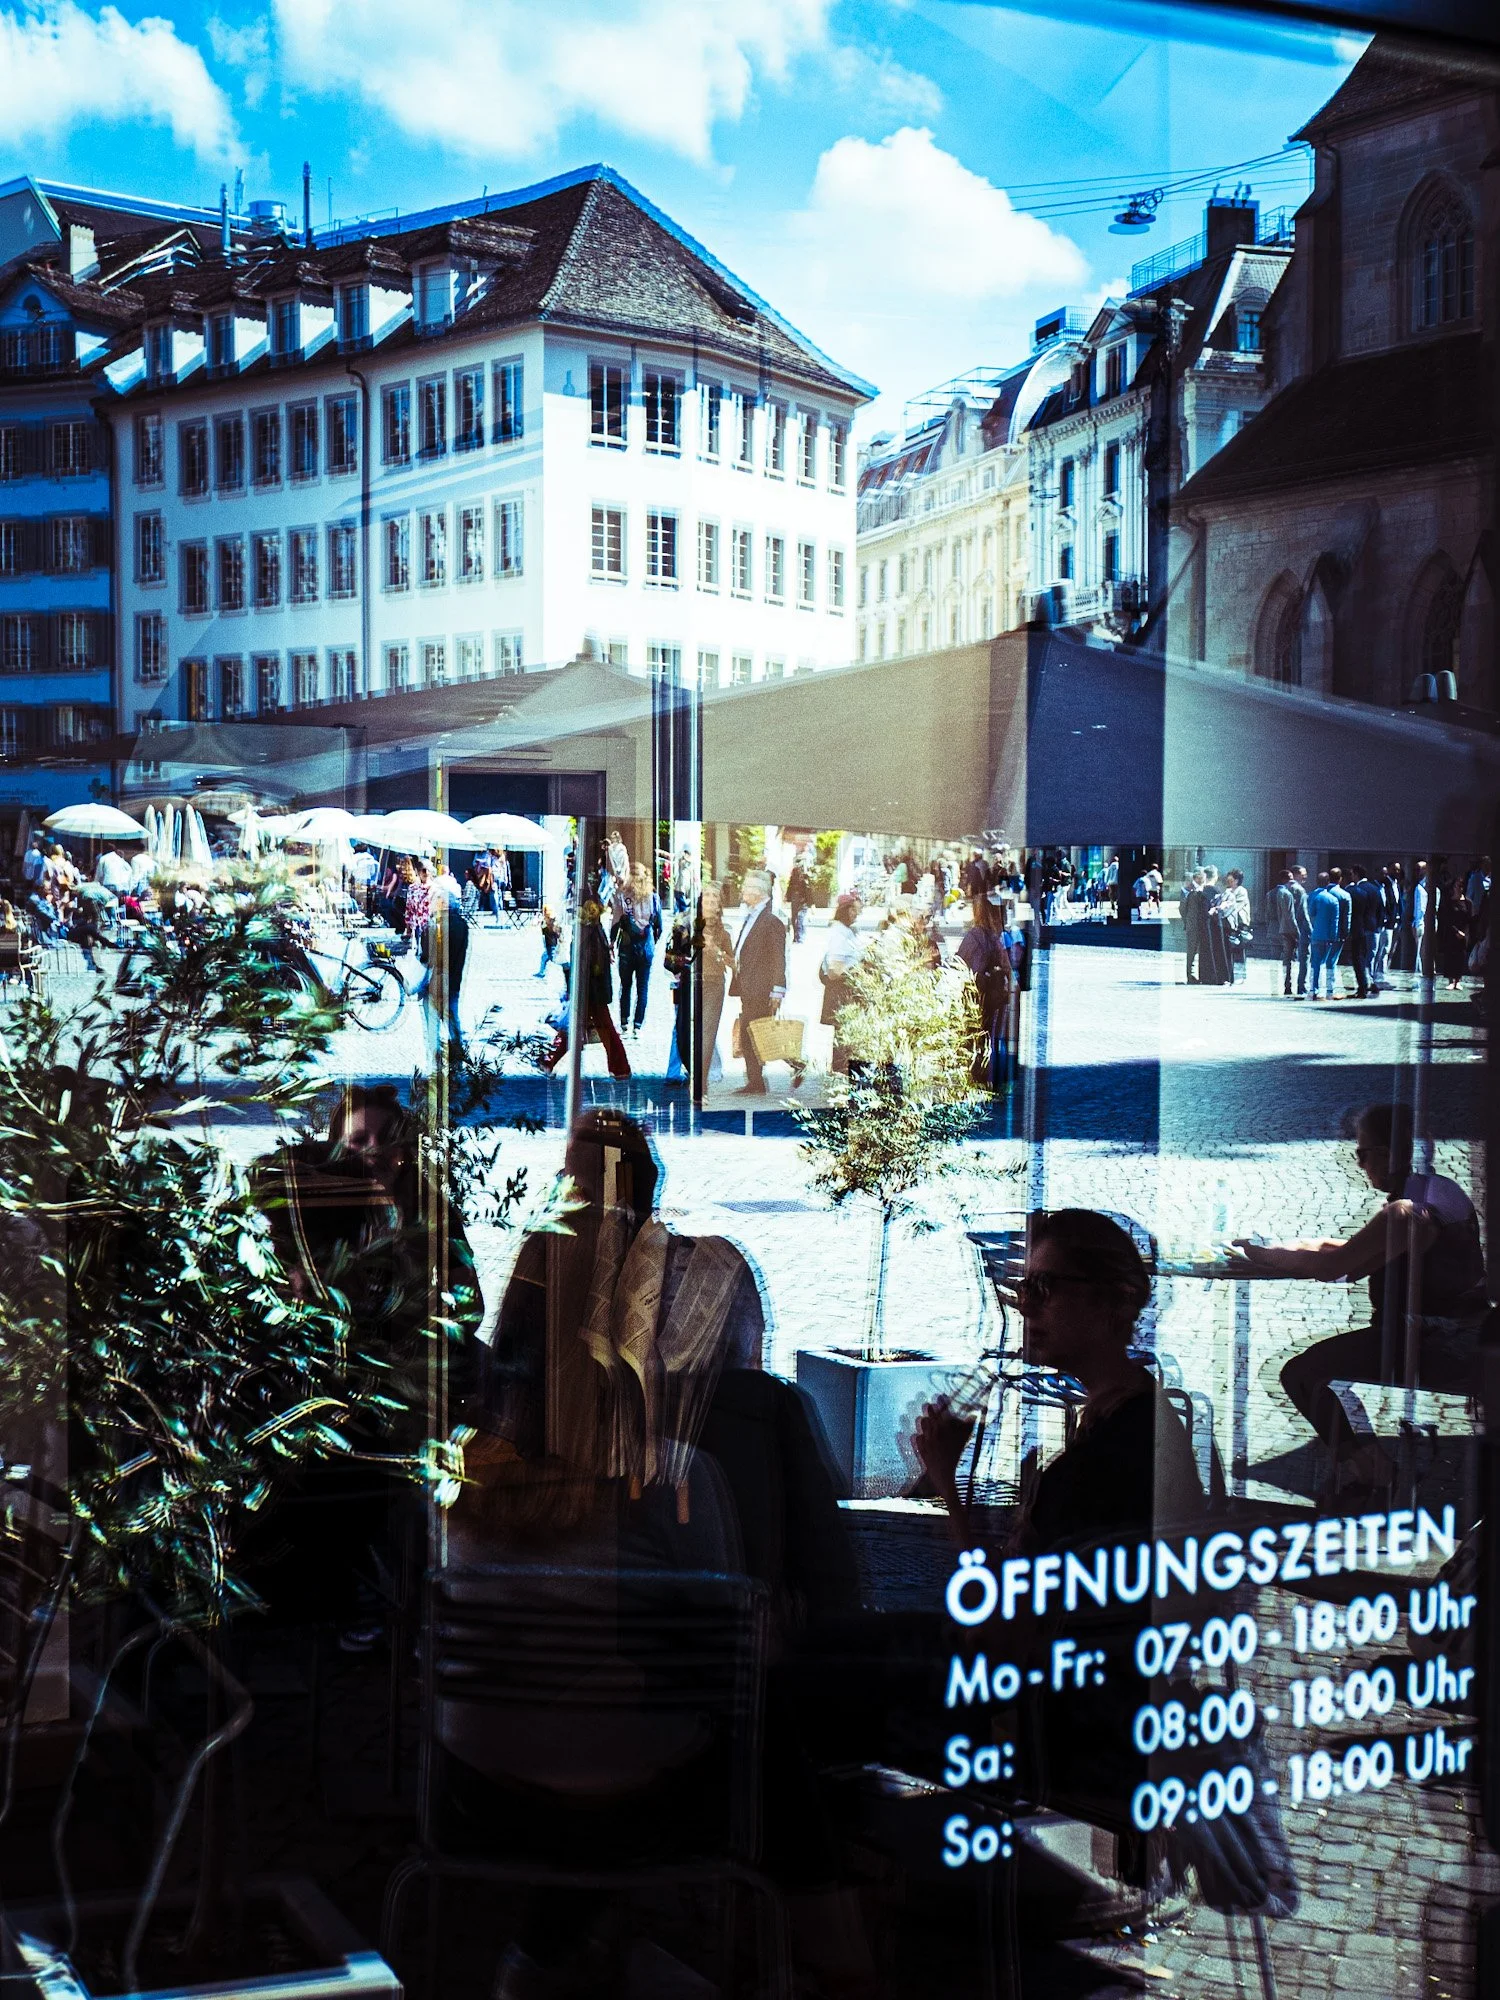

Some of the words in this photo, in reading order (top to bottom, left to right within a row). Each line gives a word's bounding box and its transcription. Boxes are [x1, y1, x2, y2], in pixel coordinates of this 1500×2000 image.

[945, 1505, 1456, 1626] ÖFFNUNGSZEITEN
[1134, 1614, 1258, 1678] 07:00
[1293, 1593, 1398, 1653] 18:00
[1409, 1583, 1477, 1636] Uhr
[944, 1735, 1015, 1788] Sa:
[1133, 1689, 1256, 1755] 08:00
[1289, 1668, 1395, 1728] 18:00
[1408, 1654, 1476, 1709] Uhr
[942, 1814, 1013, 1868] So:
[1132, 1766, 1254, 1832] 09:00
[1287, 1741, 1394, 1801] 18:00
[1406, 1728, 1474, 1781] Uhr
